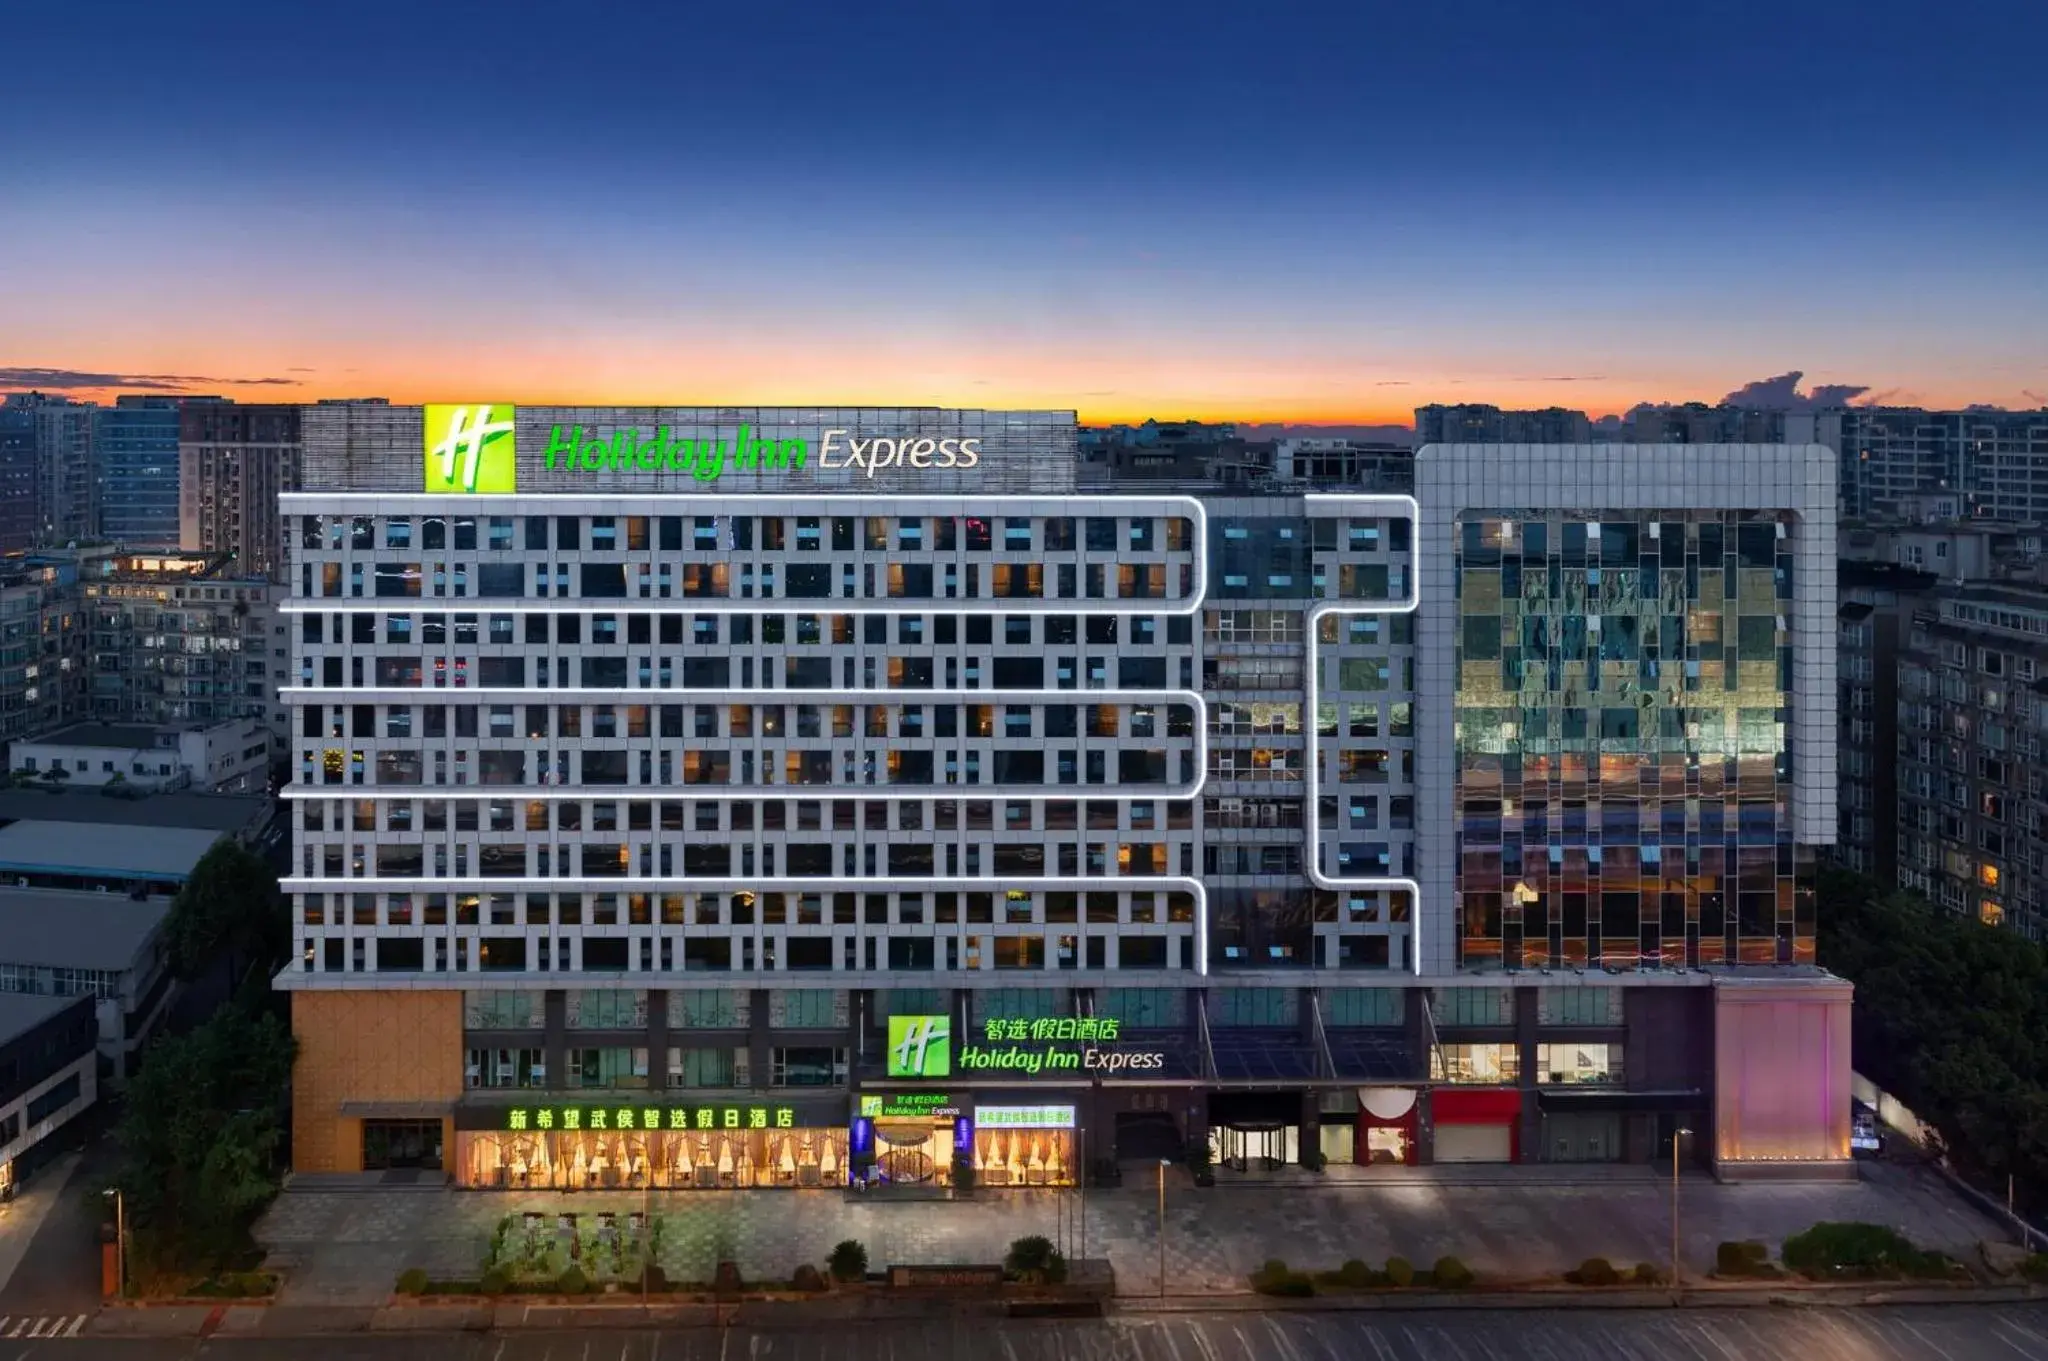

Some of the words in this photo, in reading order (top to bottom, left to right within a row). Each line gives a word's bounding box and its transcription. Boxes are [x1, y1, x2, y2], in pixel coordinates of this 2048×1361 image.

[544, 424, 726, 481] Holiday
[733, 422, 808, 469] Inn
[819, 429, 980, 479] Express
[984, 1018, 1120, 1041] 智选假日酒店
[960, 1046, 1042, 1074] Holiday
[1045, 1047, 1080, 1069] Inn
[1084, 1049, 1164, 1073] Express
[509, 1108, 794, 1130] 新希望武侯智选假日酒店
